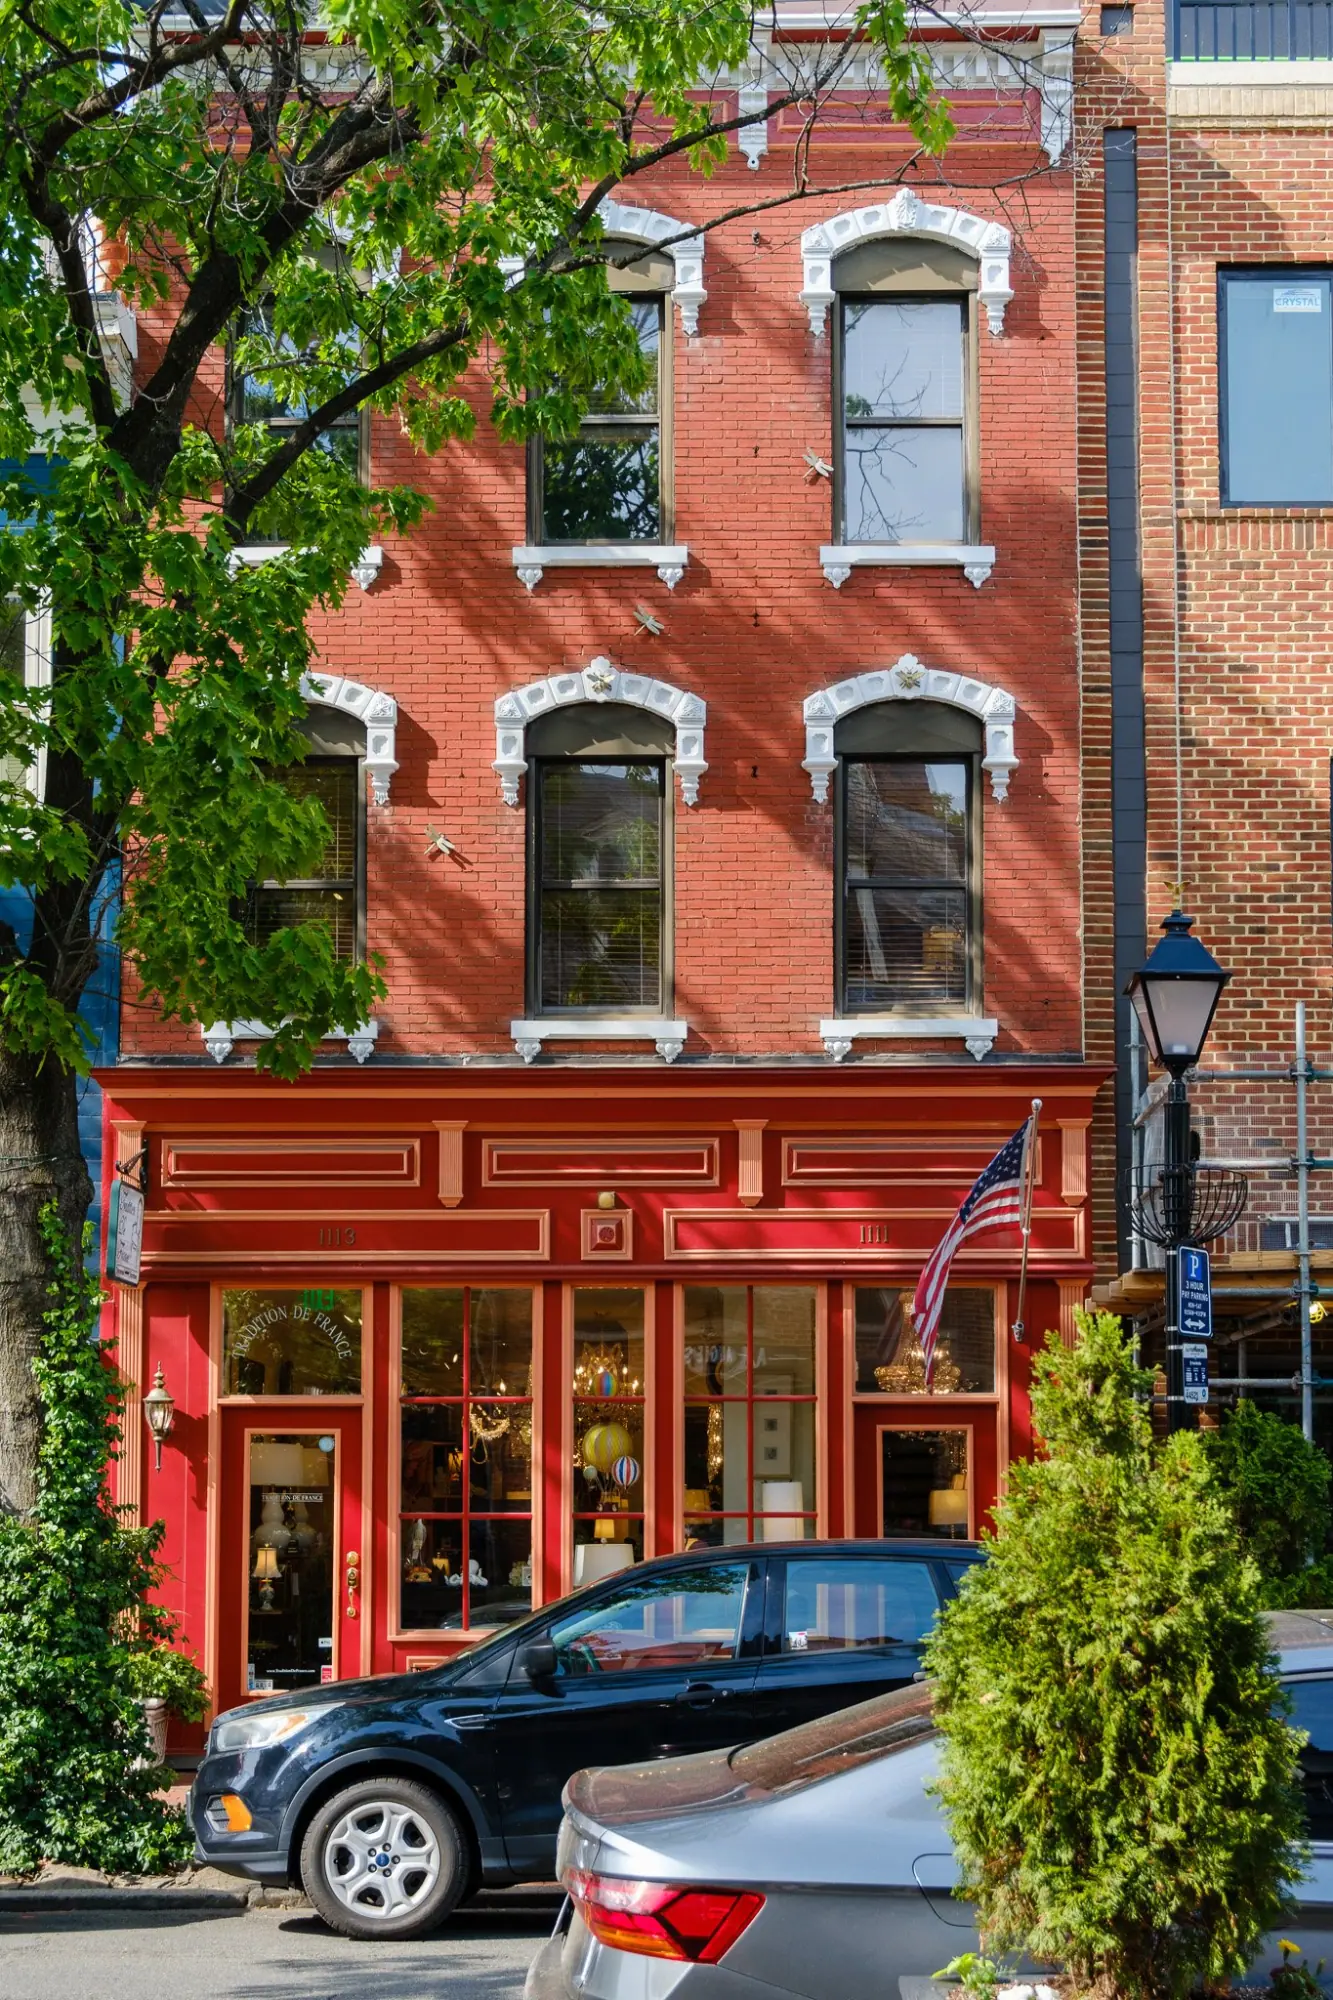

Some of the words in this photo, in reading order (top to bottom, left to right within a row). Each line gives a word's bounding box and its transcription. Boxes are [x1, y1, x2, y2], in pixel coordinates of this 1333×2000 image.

[1275, 297, 1320, 306] CRYSTAL
[320, 1227, 356, 1246] 1113
[860, 1224, 889, 1244] 1111
[1190, 1254, 1199, 1278] P
[1181, 1290, 1190, 1299] PAY
[1190, 1291, 1209, 1301] PARKING
[1190, 1281, 1204, 1291] HOUR
[231, 1305, 288, 1359] TRADITION
[293, 1305, 312, 1321] DE
[313, 1311, 353, 1359] FRANCE
